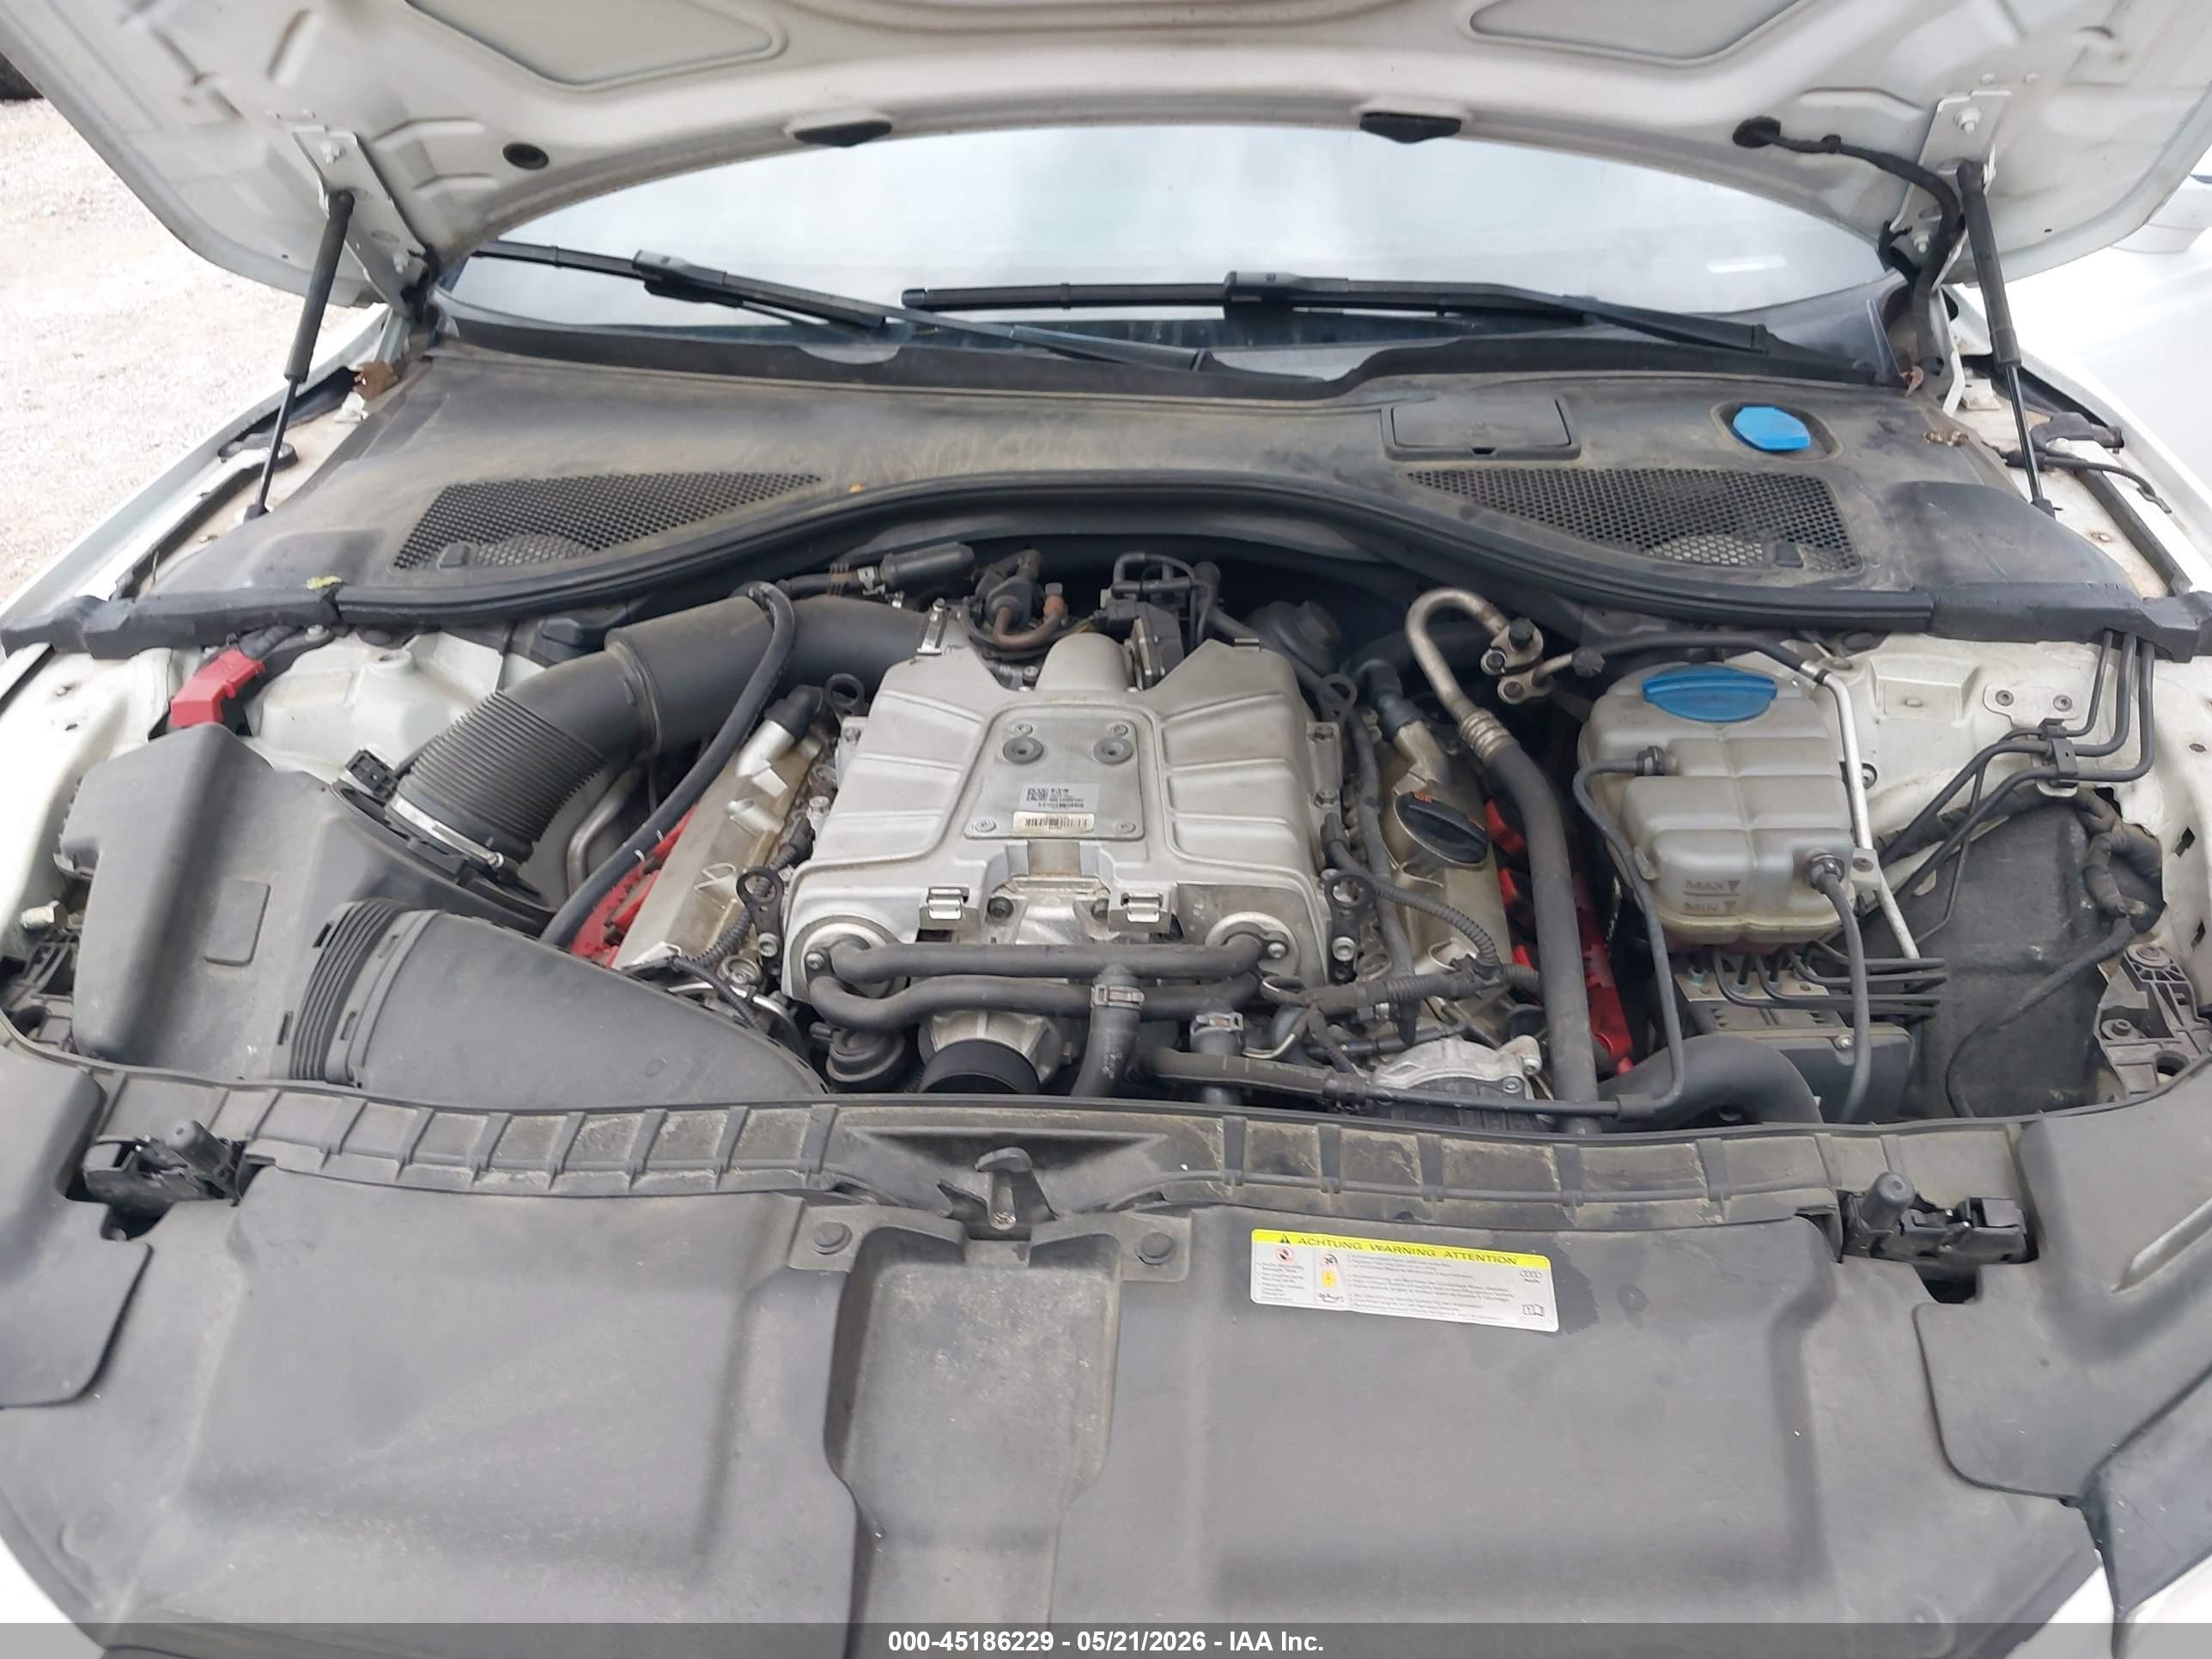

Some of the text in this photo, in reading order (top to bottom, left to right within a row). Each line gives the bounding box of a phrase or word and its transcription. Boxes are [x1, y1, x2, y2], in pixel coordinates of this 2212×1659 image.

[1686, 879, 1725, 890] MAX
[1684, 902, 1719, 913] MIN
[1298, 1237, 1519, 1265] ACHTUNG WARNING ATTENTION
